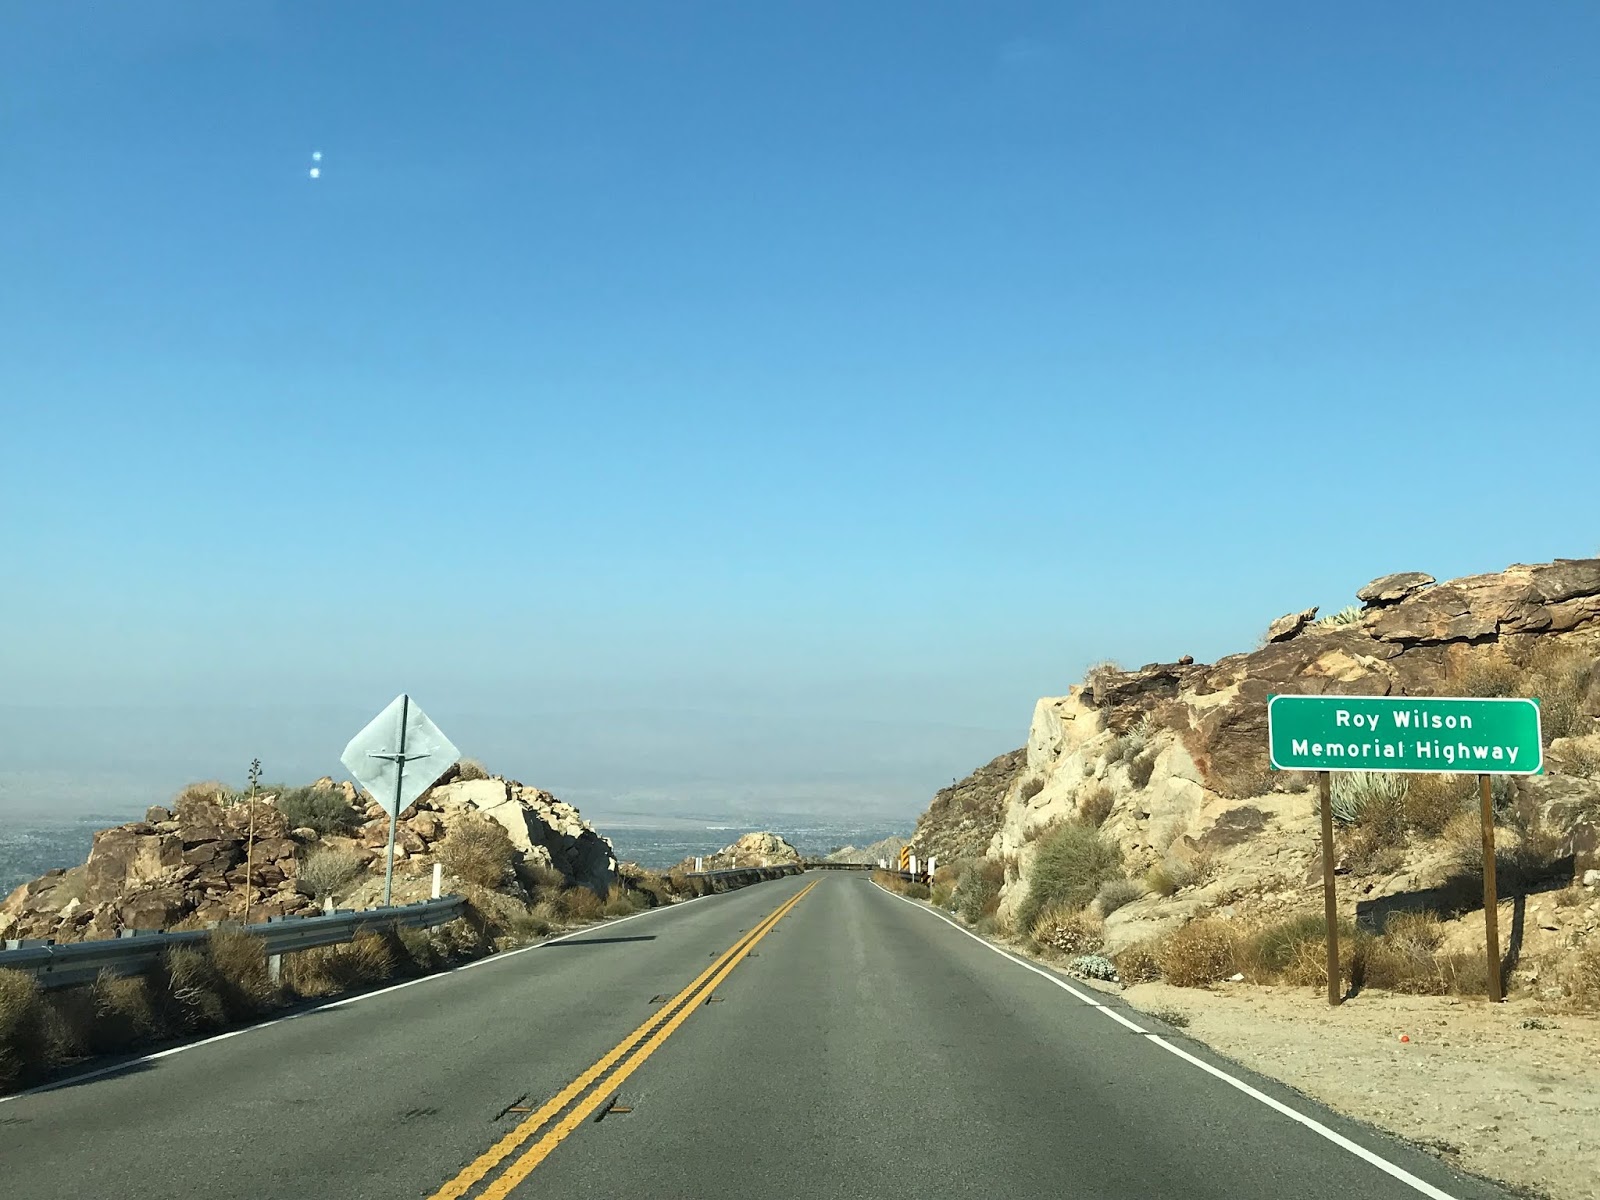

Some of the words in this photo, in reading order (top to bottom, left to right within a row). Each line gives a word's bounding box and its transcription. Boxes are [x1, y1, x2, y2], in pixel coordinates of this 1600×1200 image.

[1336, 709, 1380, 731] Roy
[1392, 709, 1473, 729] Wilson
[1291, 738, 1404, 758] Memorial
[1416, 740, 1519, 764] Highway
